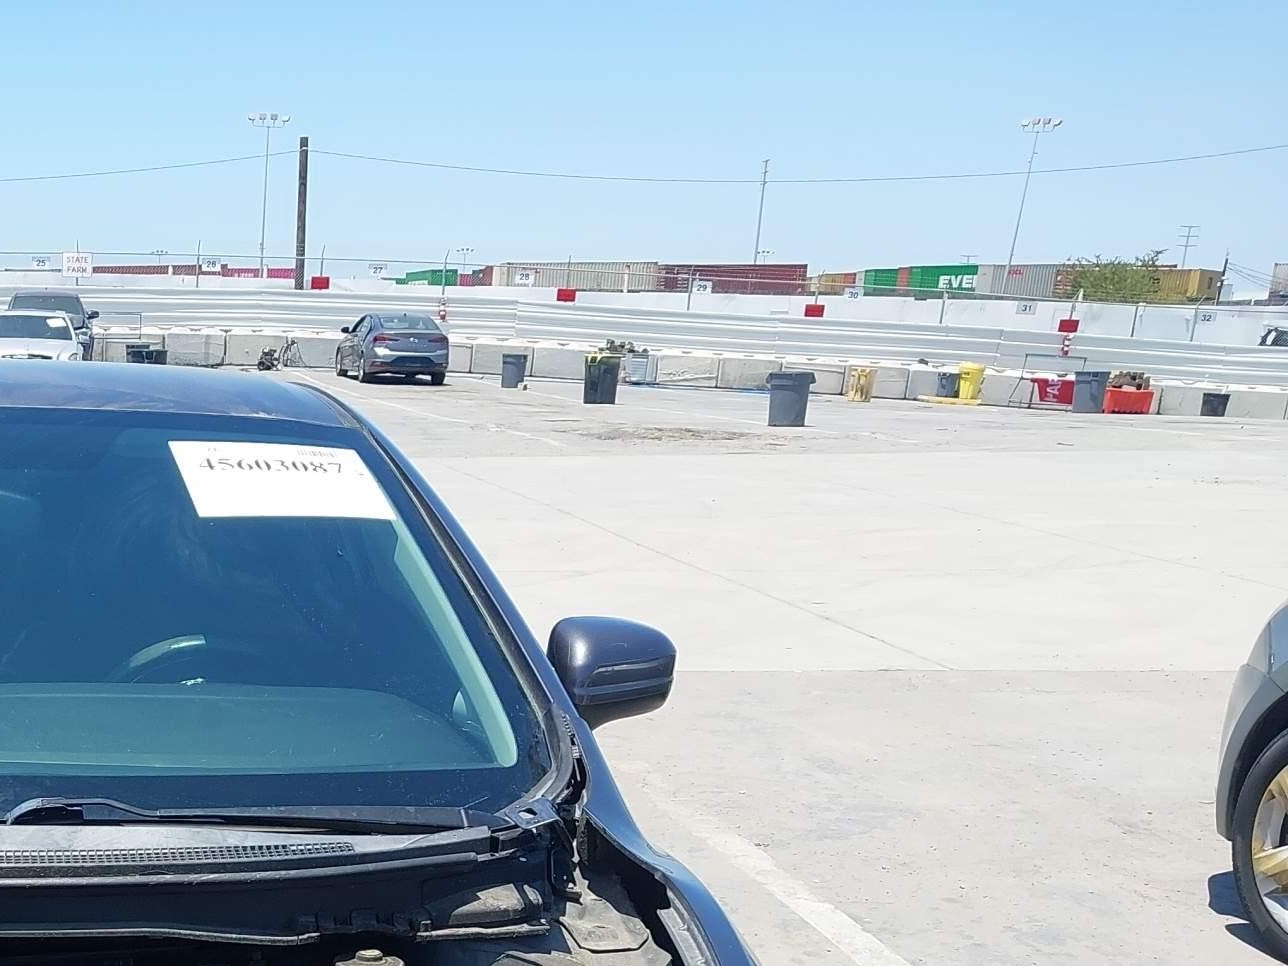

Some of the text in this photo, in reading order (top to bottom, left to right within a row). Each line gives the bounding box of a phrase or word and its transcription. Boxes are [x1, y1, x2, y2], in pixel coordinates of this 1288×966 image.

[35, 259, 47, 267] 25
[66, 256, 89, 264] STATE
[206, 260, 217, 269] 26
[372, 266, 384, 275] 27
[519, 272, 531, 281] 28
[696, 284, 708, 292] 29
[848, 291, 859, 299] 30
[1021, 304, 1032, 313] 31
[1200, 314, 1212, 322] 32
[199, 457, 343, 474] 45603087
